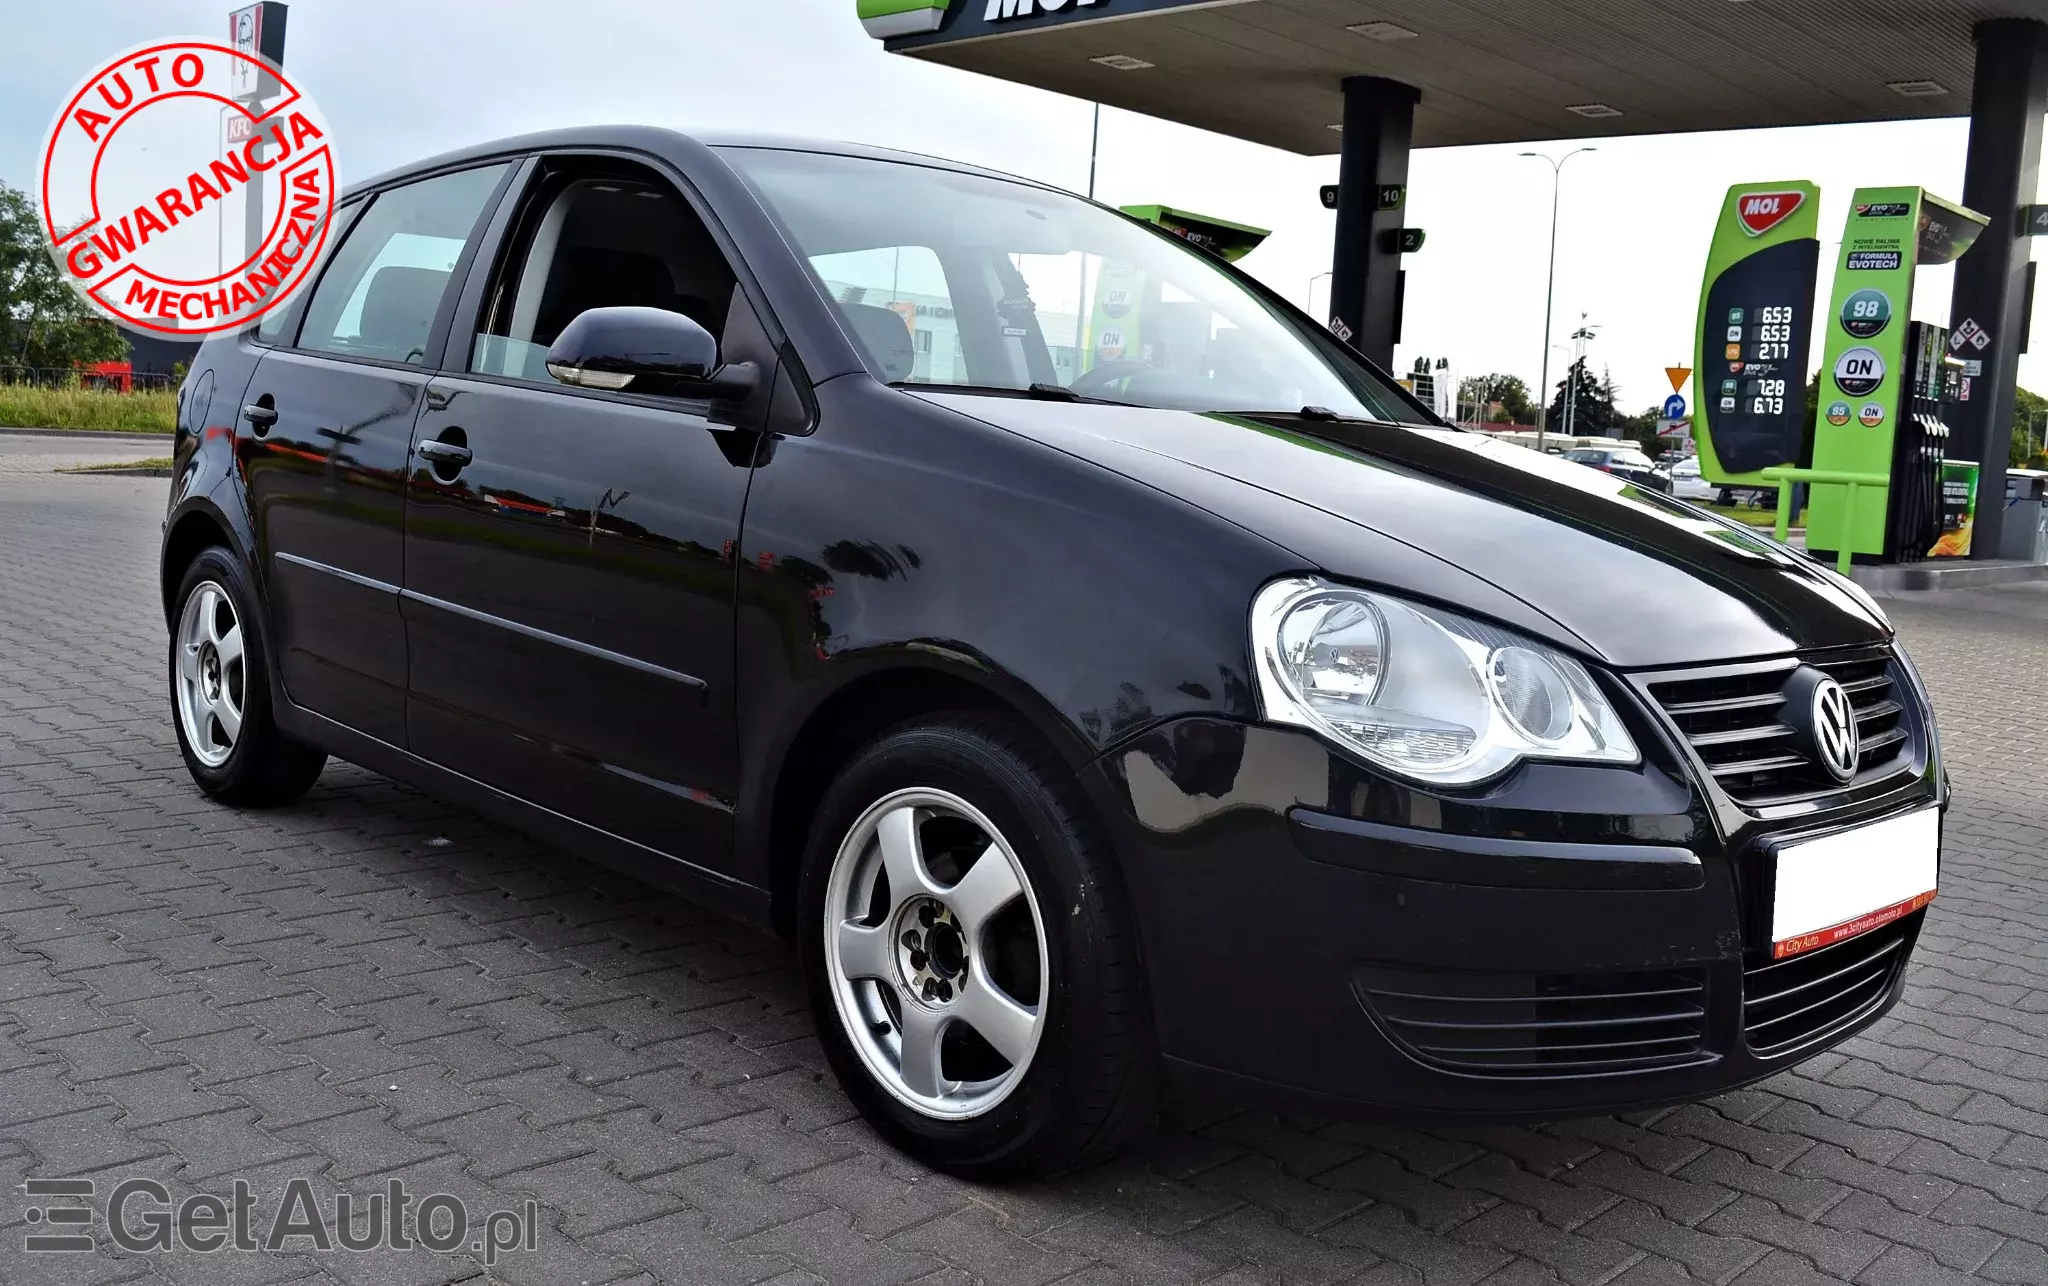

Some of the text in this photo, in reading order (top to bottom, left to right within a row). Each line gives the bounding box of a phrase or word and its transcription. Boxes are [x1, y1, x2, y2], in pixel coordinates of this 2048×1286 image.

[229, 118, 251, 139] KFC
[1326, 192, 1334, 202] 9
[1383, 190, 1398, 202] 10
[1744, 198, 1780, 215] MOL
[1405, 235, 1414, 245] 2
[1848, 260, 1898, 269] EVOTECH
[1853, 300, 1879, 317] 98
[1103, 332, 1120, 345] ON
[1845, 359, 1874, 375] ON
[1832, 406, 1879, 416] 95 ON
[1786, 934, 1820, 952] City Auto
